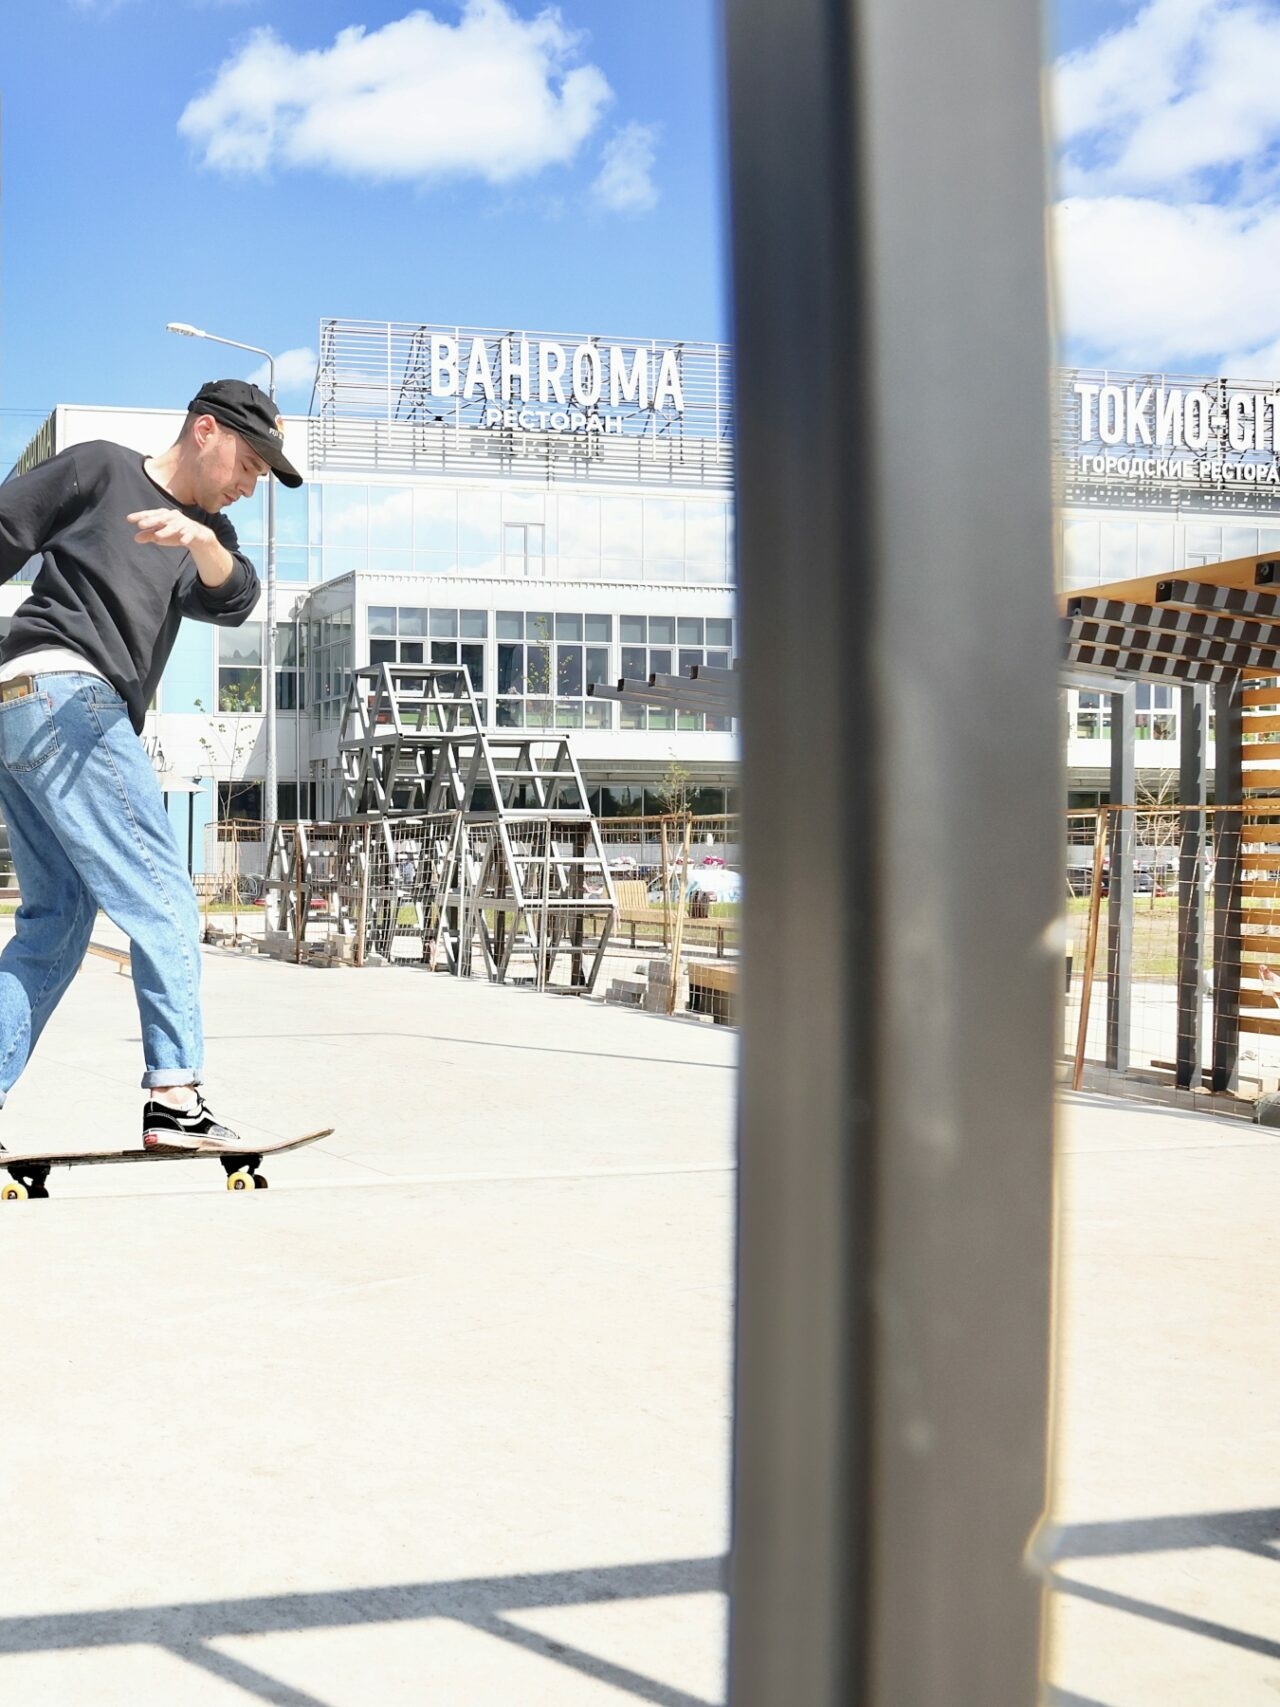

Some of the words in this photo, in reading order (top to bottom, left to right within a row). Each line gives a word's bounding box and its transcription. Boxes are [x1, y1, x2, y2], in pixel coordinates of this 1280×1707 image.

[430, 335, 685, 412] BAHROMA
[486, 408, 623, 433] РЕСТОРАН
[1081, 455, 1195, 479] ГОРОДСКИЕ
[1200, 461, 1280, 482] РЕСТОРА
